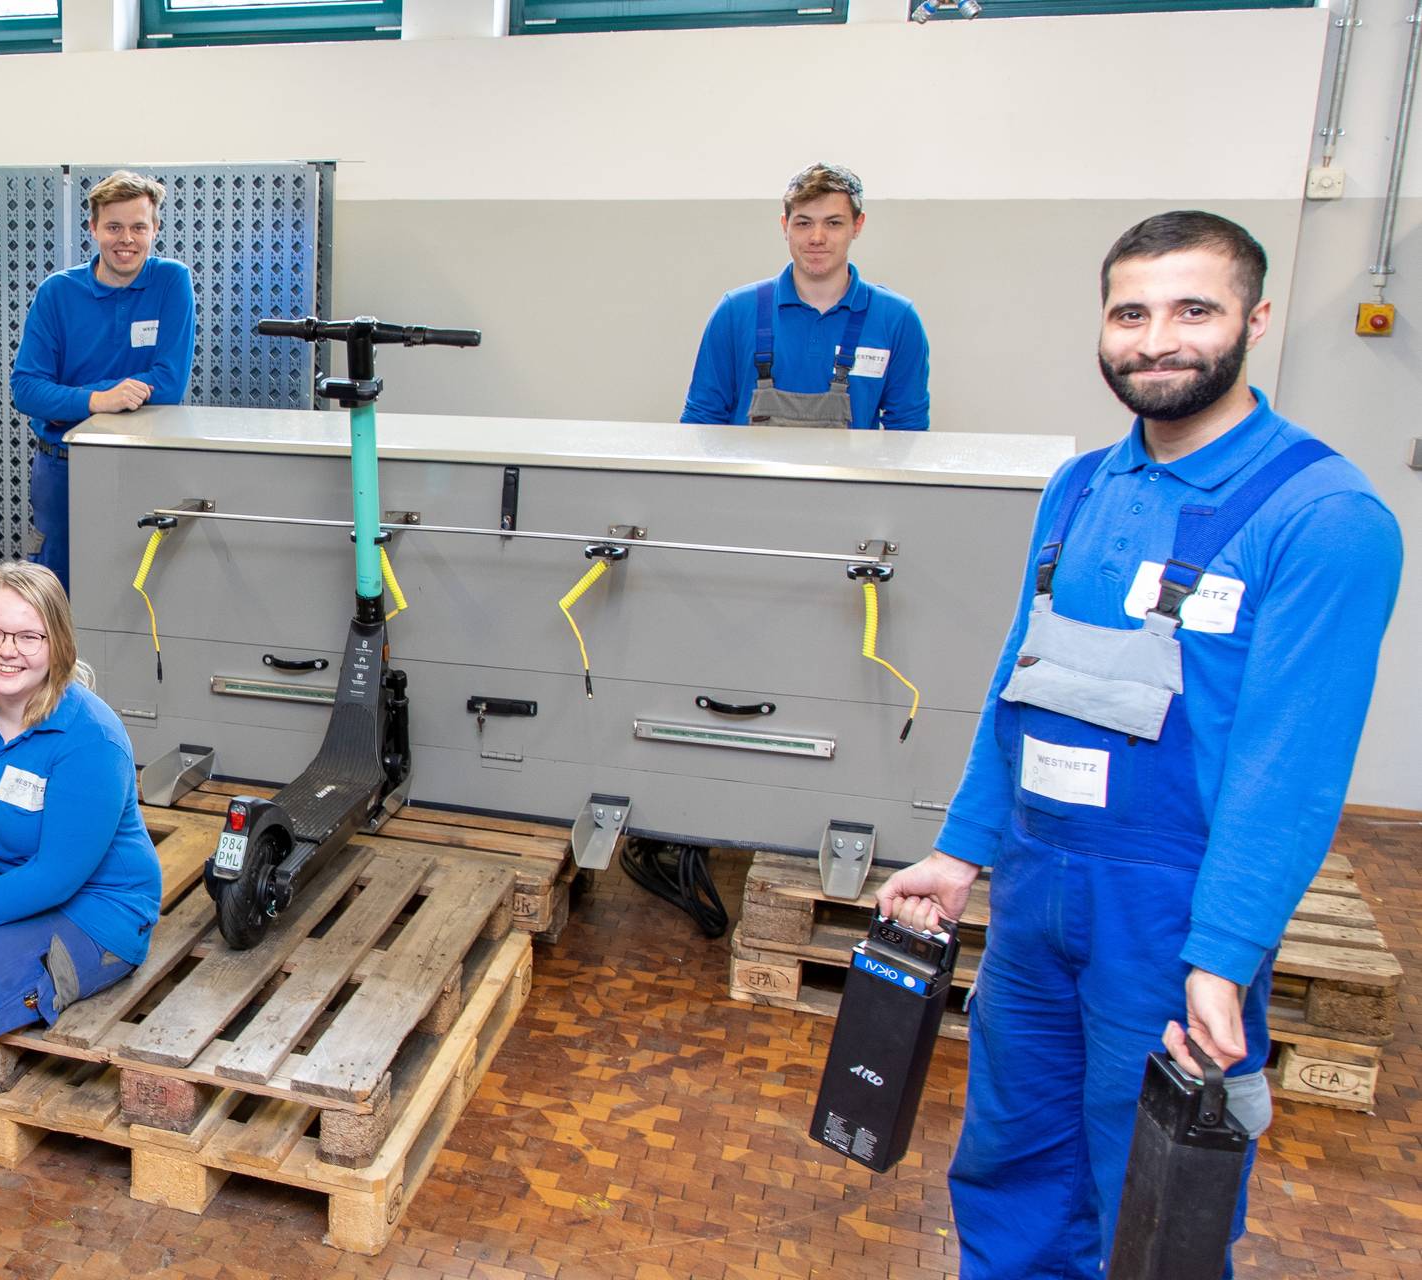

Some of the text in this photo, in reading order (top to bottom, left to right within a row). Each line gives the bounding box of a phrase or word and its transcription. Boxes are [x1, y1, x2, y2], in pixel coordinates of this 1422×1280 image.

[856, 354, 886, 362] ESTNETZ
[1195, 588, 1230, 602] NETZ
[1036, 753, 1098, 773] WESTNETZ
[221, 836, 243, 852] 984
[218, 851, 239, 867] PML
[1308, 1068, 1350, 1088] EPAL
